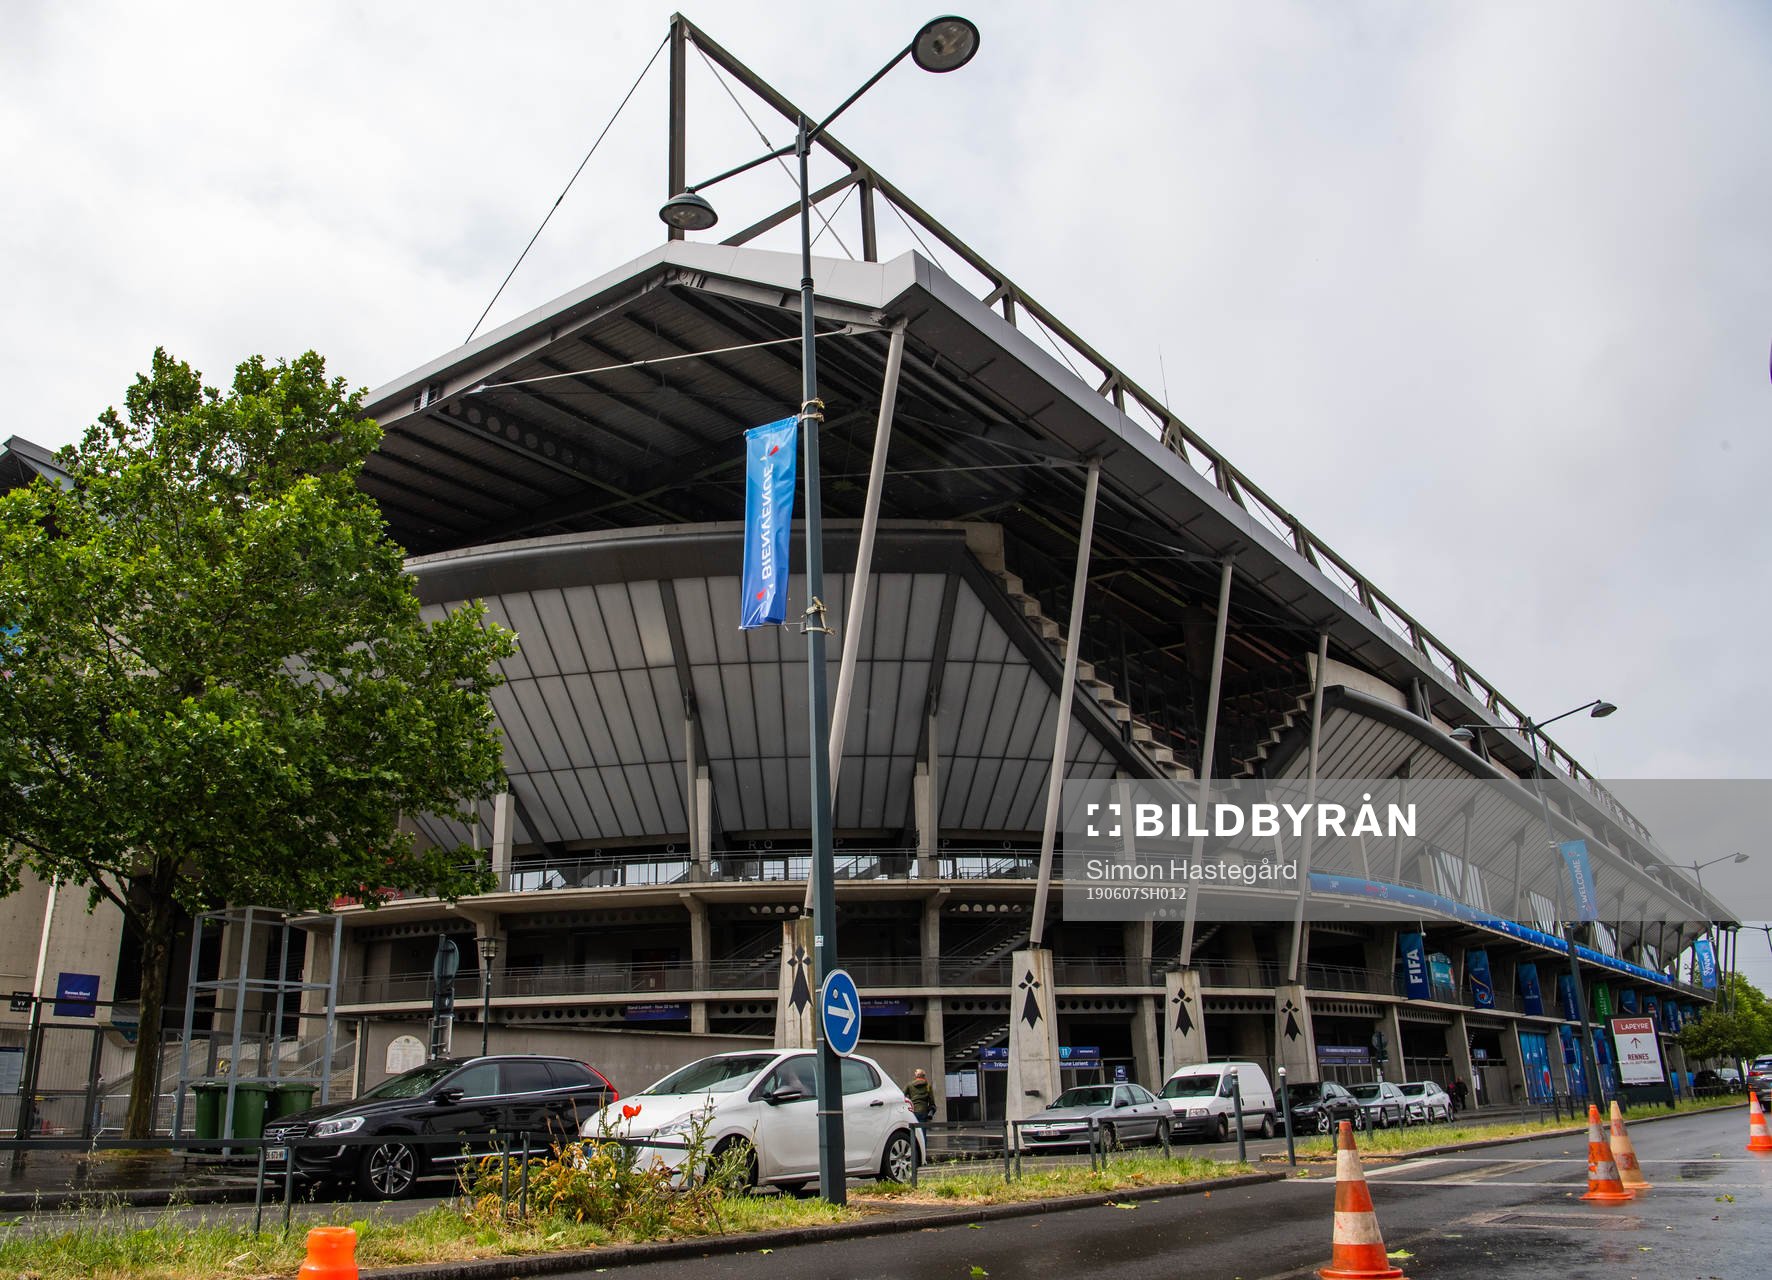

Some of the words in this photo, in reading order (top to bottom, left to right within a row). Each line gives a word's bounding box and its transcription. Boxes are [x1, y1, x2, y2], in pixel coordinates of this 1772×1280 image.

[942, 839, 950, 848] P
[594, 848, 602, 857] R
[1572, 859, 1588, 903] WELCOME
[1407, 948, 1423, 984] FIFA
[1620, 1022, 1649, 1031] LAPEYRE
[1627, 1053, 1650, 1061] RENNES
